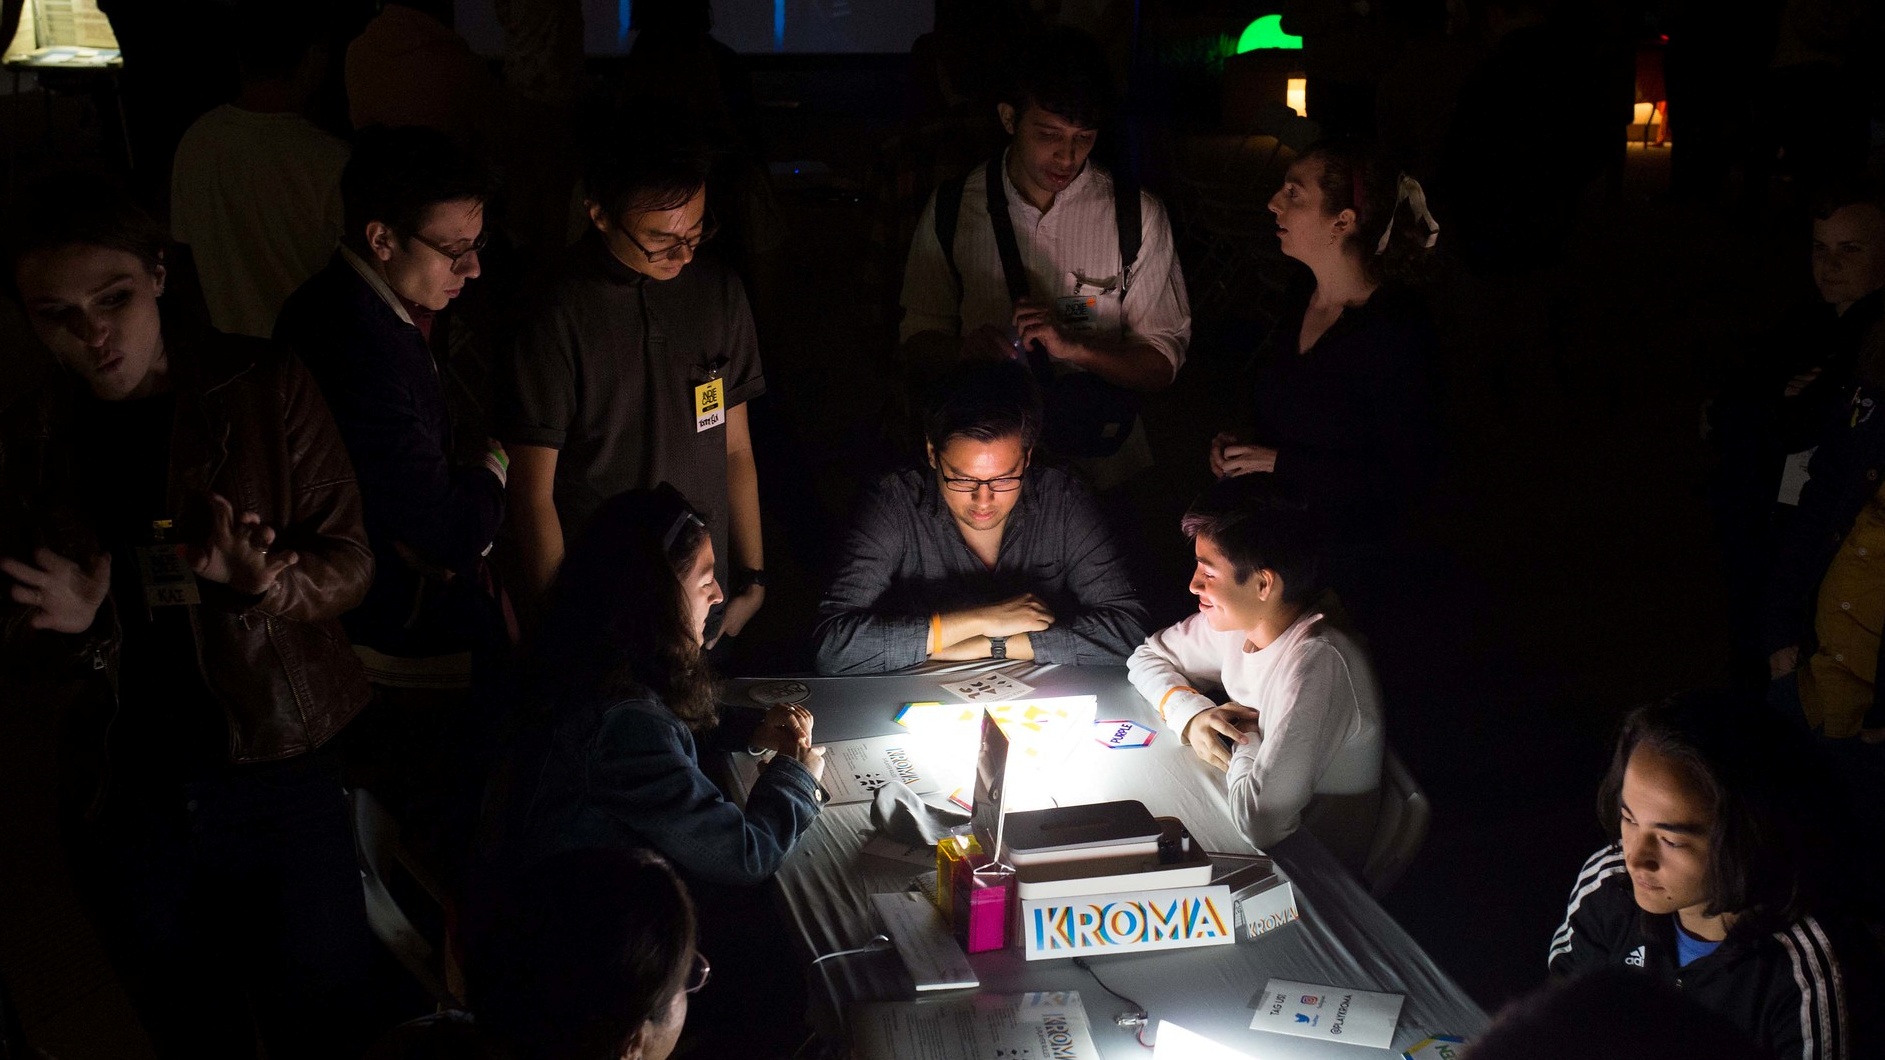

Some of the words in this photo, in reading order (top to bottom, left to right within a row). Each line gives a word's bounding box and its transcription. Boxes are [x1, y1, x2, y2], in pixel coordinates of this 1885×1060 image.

[1110, 723, 1133, 744] PURPLE
[885, 747, 921, 785] KROMA
[1034, 896, 1229, 950] KROMA
[1247, 905, 1299, 938] KROMA
[1269, 1003, 1282, 1016] TAG
[1330, 994, 1352, 1035] @PLAYKROMA
